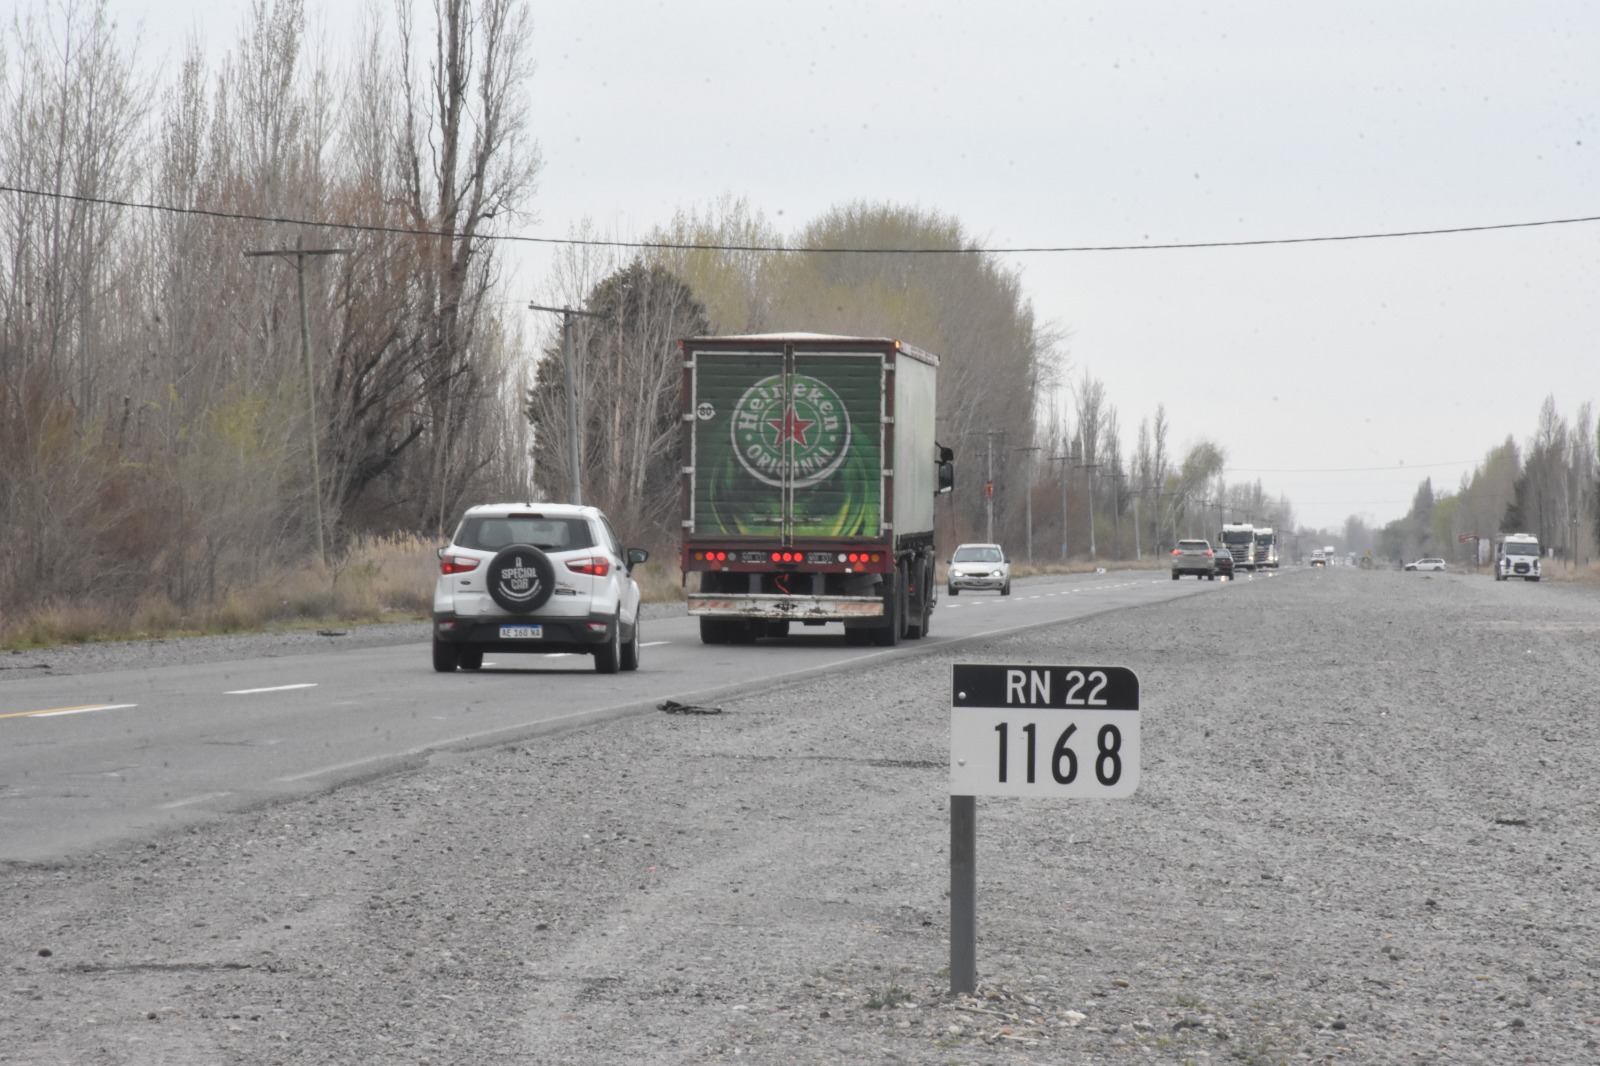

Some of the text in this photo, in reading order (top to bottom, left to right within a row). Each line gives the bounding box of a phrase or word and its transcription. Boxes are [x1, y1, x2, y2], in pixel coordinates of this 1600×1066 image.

[700, 407, 711, 416] 80
[738, 383, 839, 431] Heineken
[746, 445, 836, 477] ORIGINAL
[501, 567, 538, 579] SPECIAL
[515, 556, 522, 568] A
[510, 578, 529, 590] CAR
[1006, 669, 1108, 705] RN 22
[994, 722, 1122, 787] 1168
